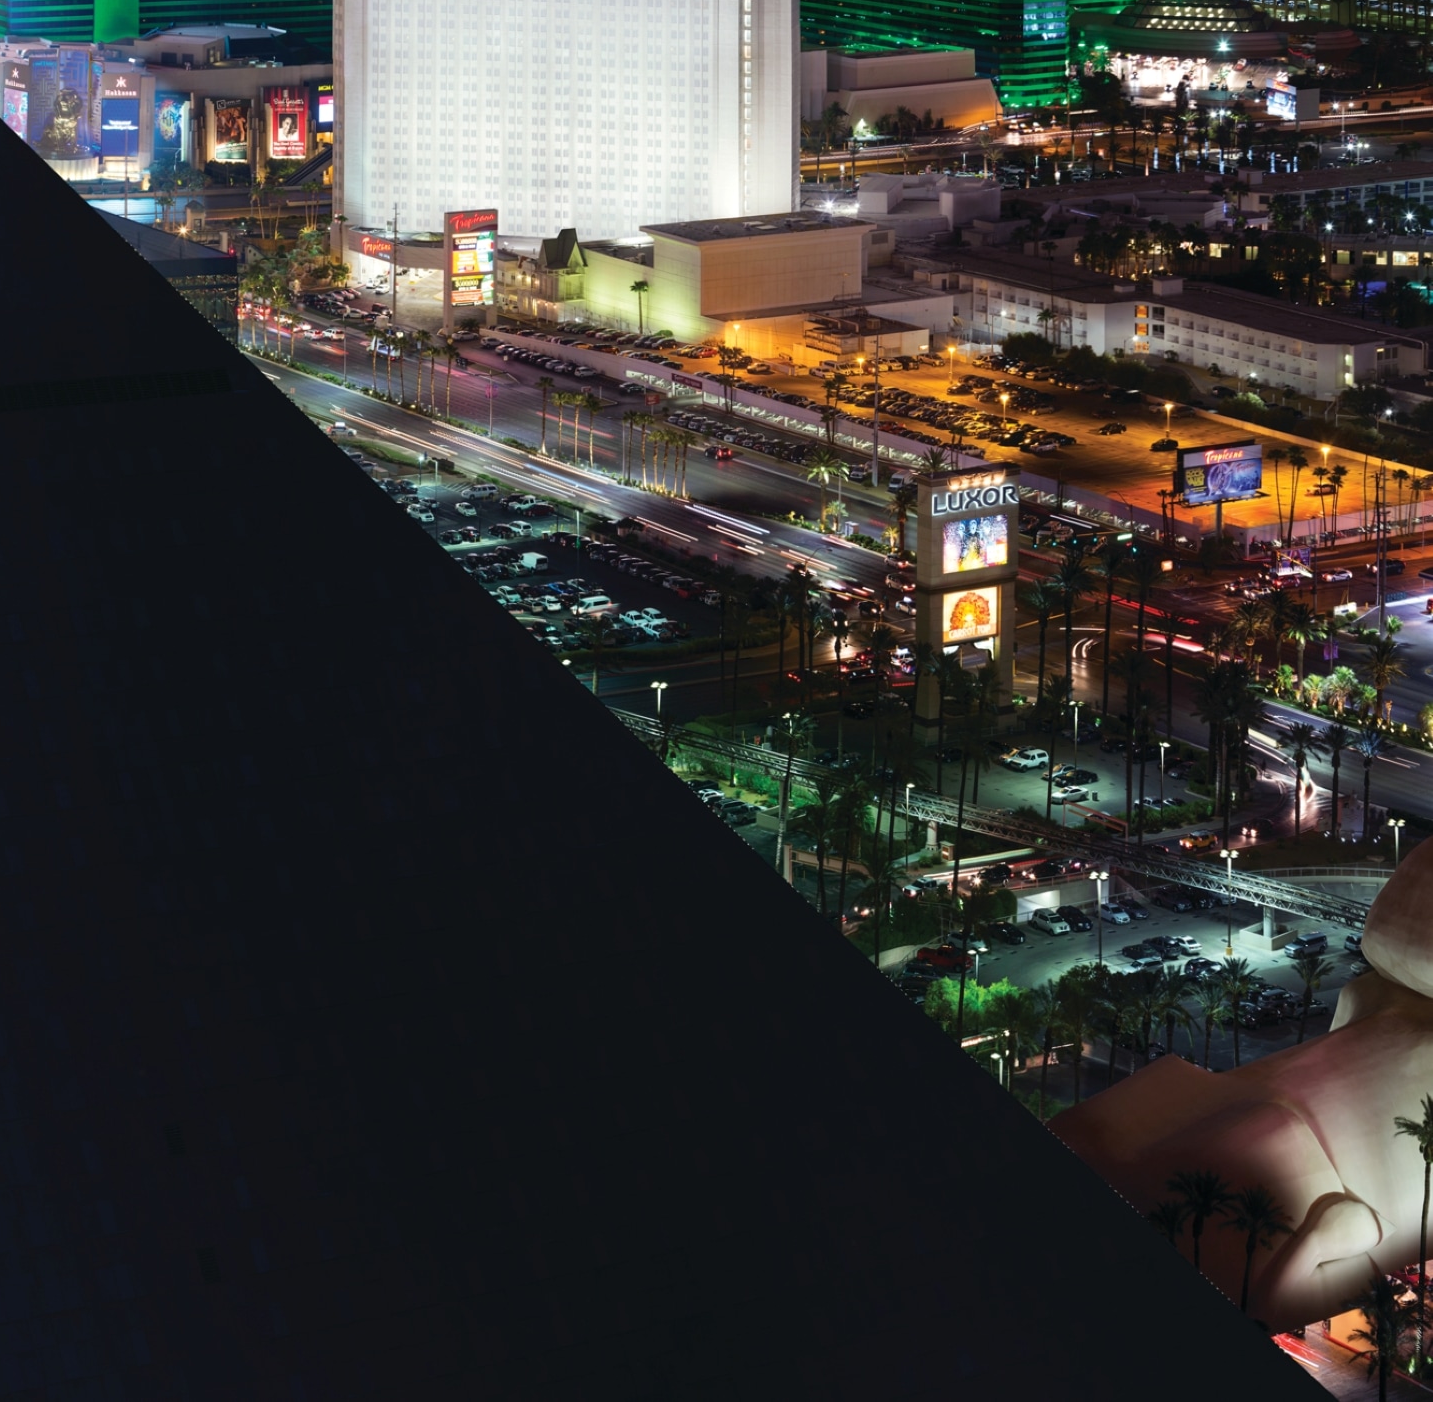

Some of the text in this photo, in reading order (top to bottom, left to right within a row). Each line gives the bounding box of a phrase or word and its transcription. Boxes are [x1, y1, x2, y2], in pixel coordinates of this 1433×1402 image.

[449, 212, 496, 232] Tropicana
[361, 235, 392, 256] Tropicana
[1204, 449, 1244, 466] Tropicana
[932, 483, 1020, 516] LUXOR
